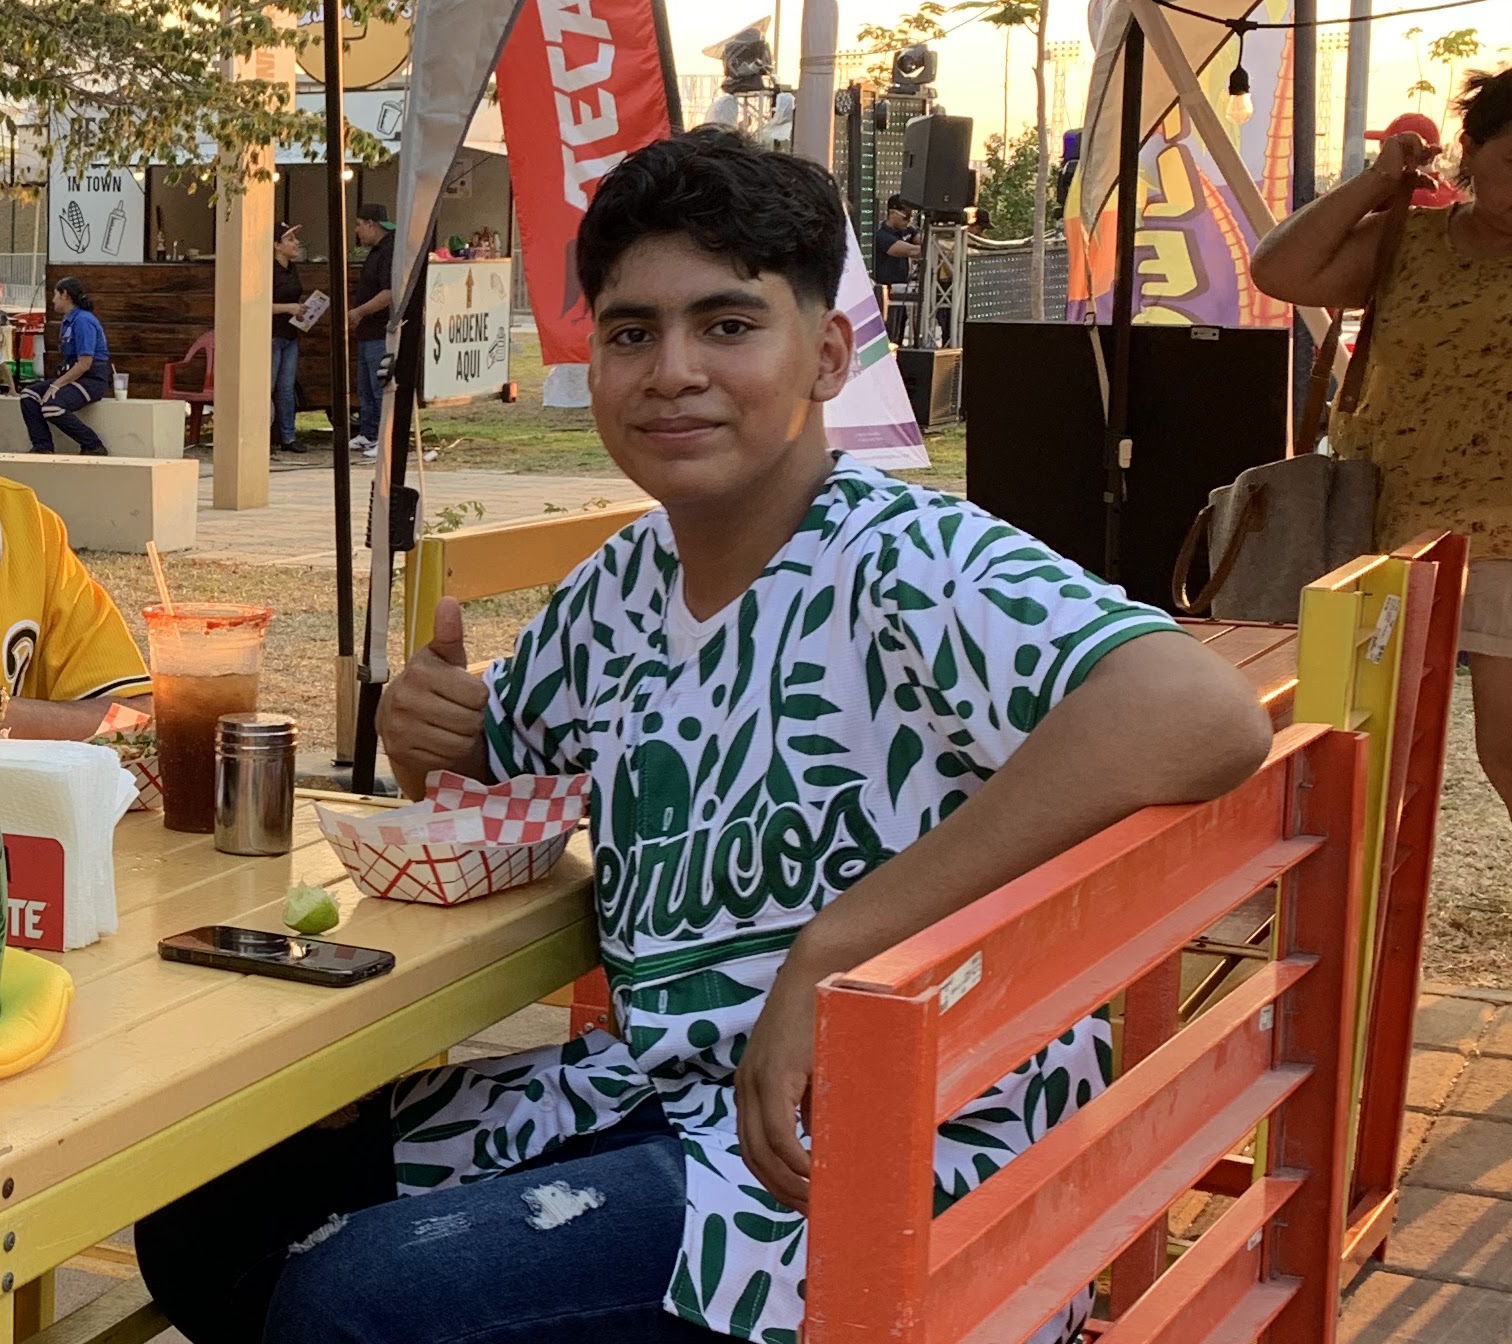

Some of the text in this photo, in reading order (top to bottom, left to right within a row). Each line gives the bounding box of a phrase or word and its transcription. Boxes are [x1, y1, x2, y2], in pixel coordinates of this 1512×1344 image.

[67, 174, 122, 193] IN TOWN
[448, 312, 489, 345] ORDENE
[455, 348, 481, 383] AQUI
[594, 779, 901, 949] ericos
